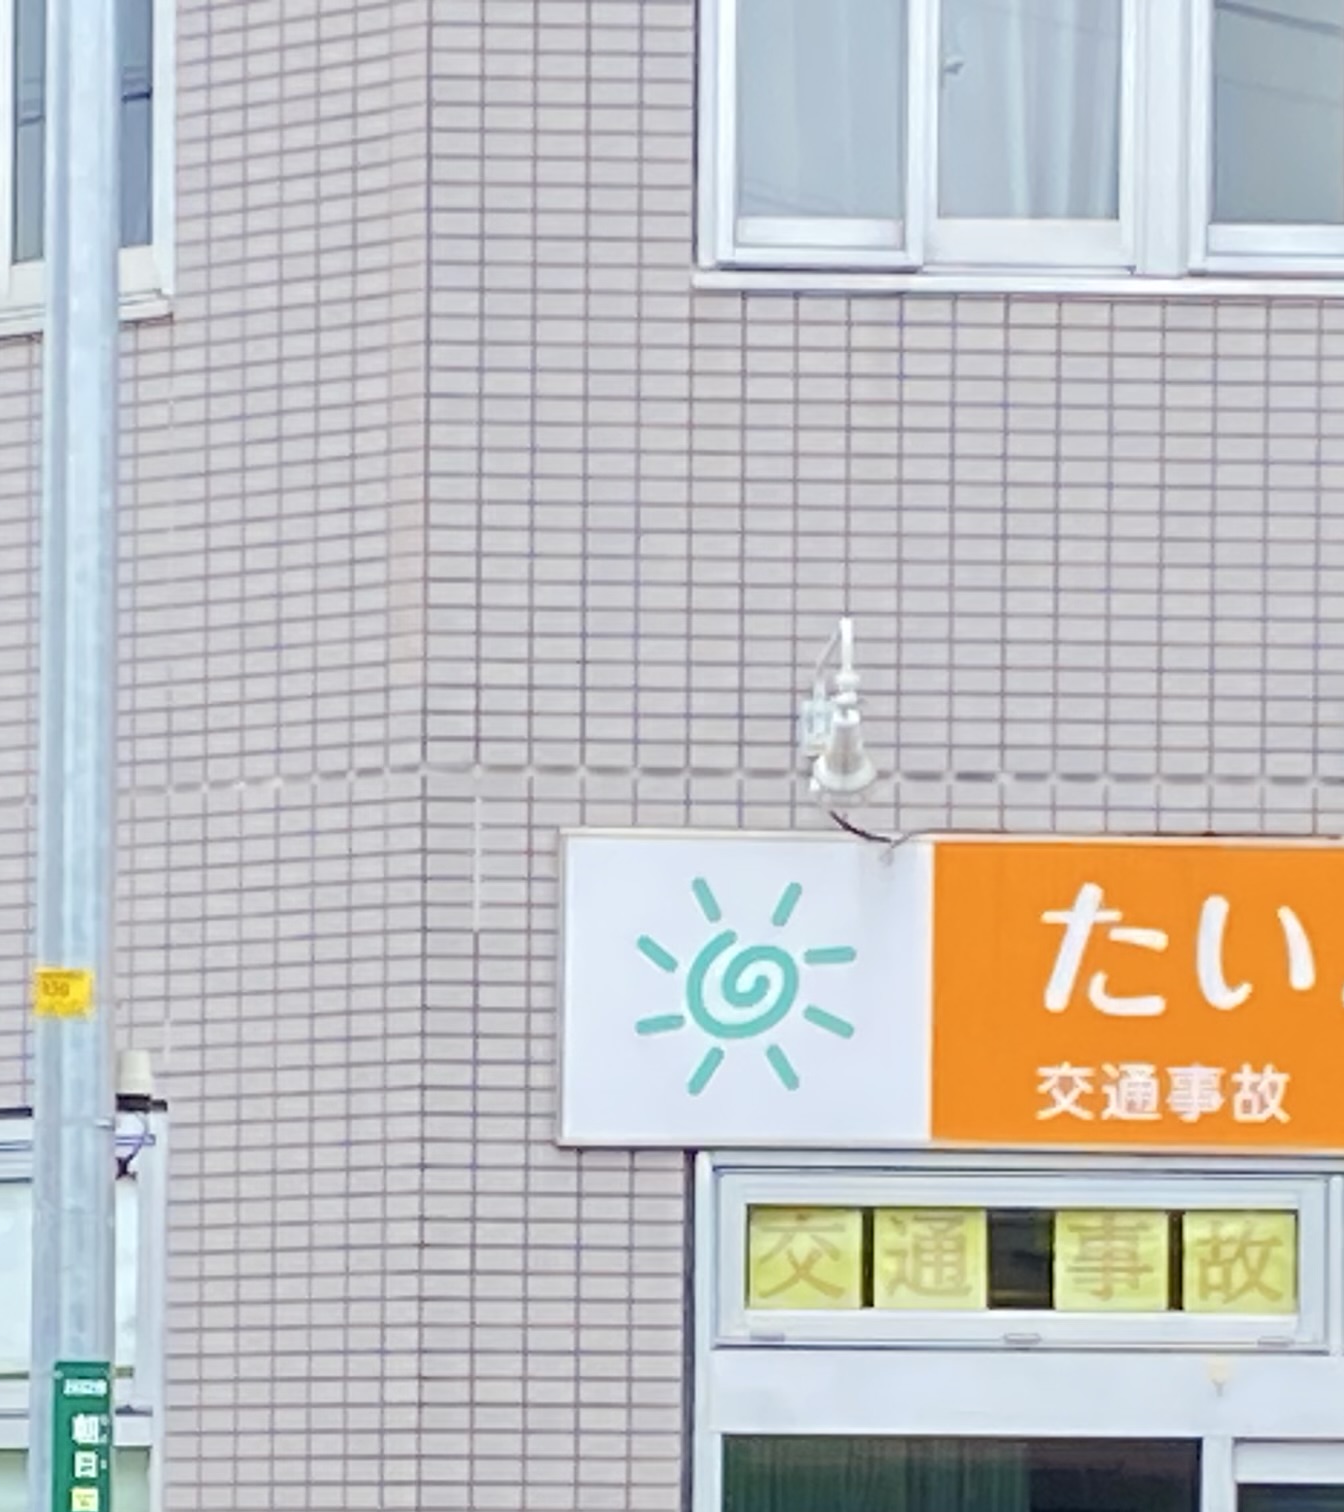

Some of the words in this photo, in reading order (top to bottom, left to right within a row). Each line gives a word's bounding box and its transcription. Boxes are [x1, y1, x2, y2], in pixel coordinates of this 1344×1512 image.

[1035, 1063, 1291, 1124] 交通事故
[755, 1210, 1285, 1304] 交通事故
